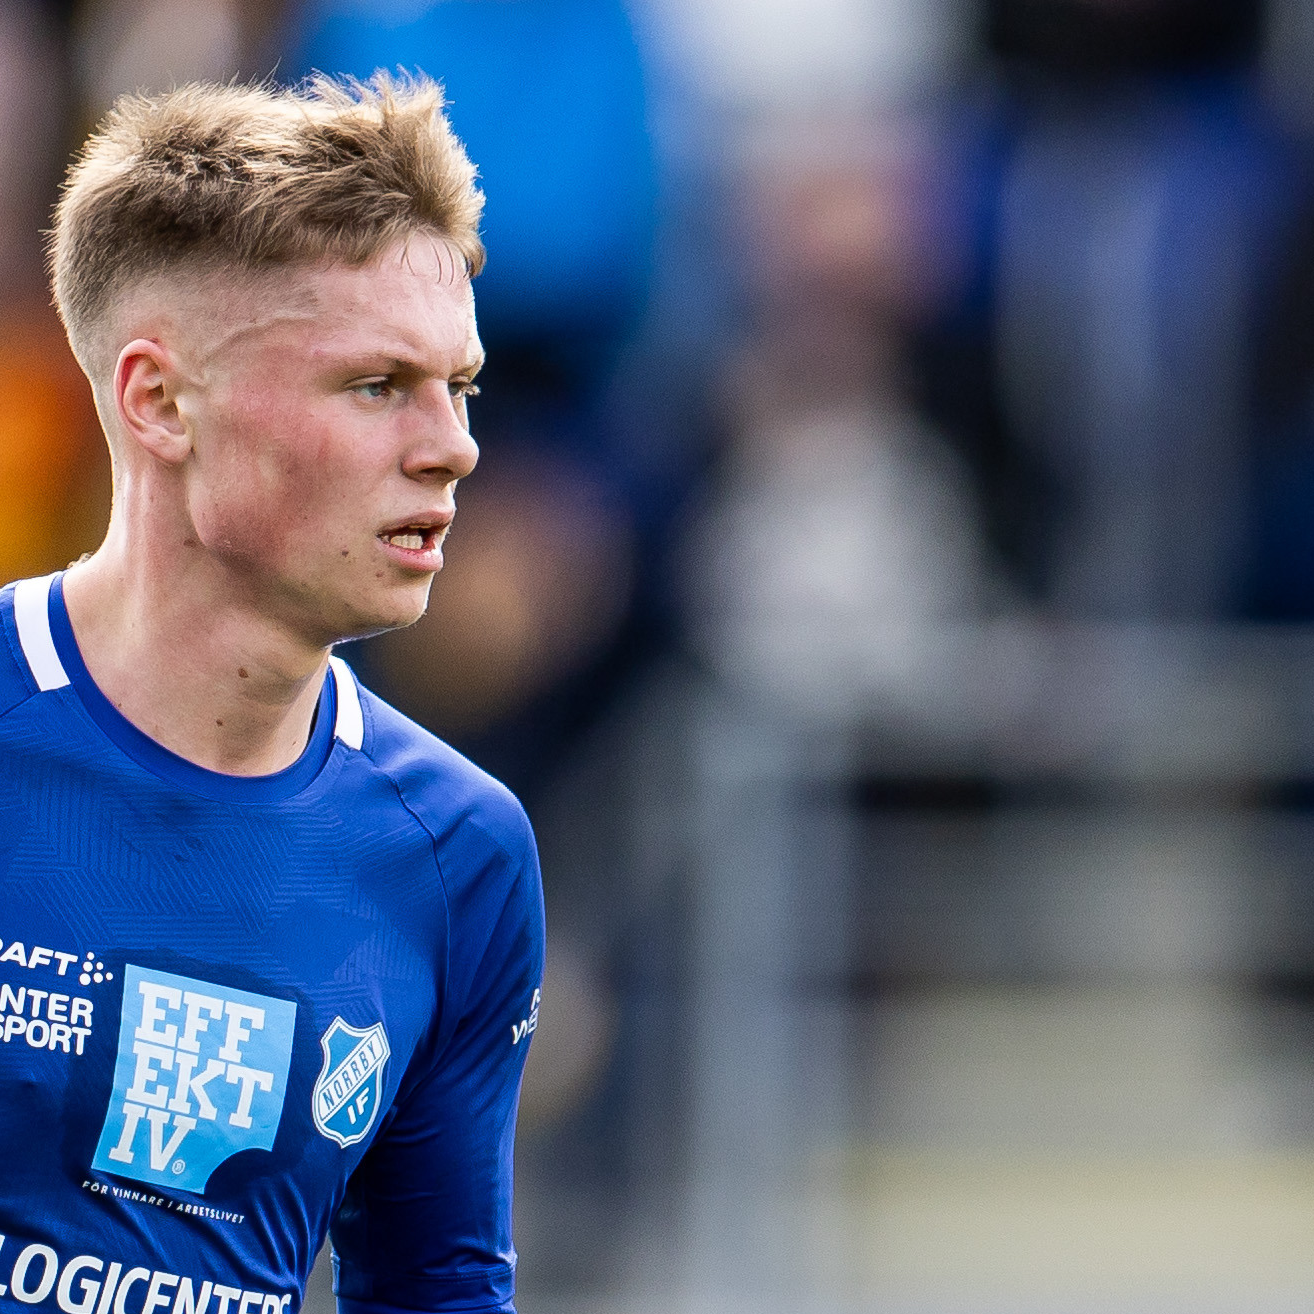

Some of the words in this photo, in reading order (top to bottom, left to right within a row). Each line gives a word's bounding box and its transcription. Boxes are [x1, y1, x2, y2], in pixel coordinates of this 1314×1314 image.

[135, 980, 266, 1063] EFF
[125, 1040, 275, 1129] EKT
[321, 1040, 378, 1111] NORRBY
[347, 1086, 370, 1125] IF
[82, 1180, 109, 1195] FÖR
[112, 1187, 165, 1206] VINNARE
[176, 1203, 246, 1224] ARBETSLIVET
